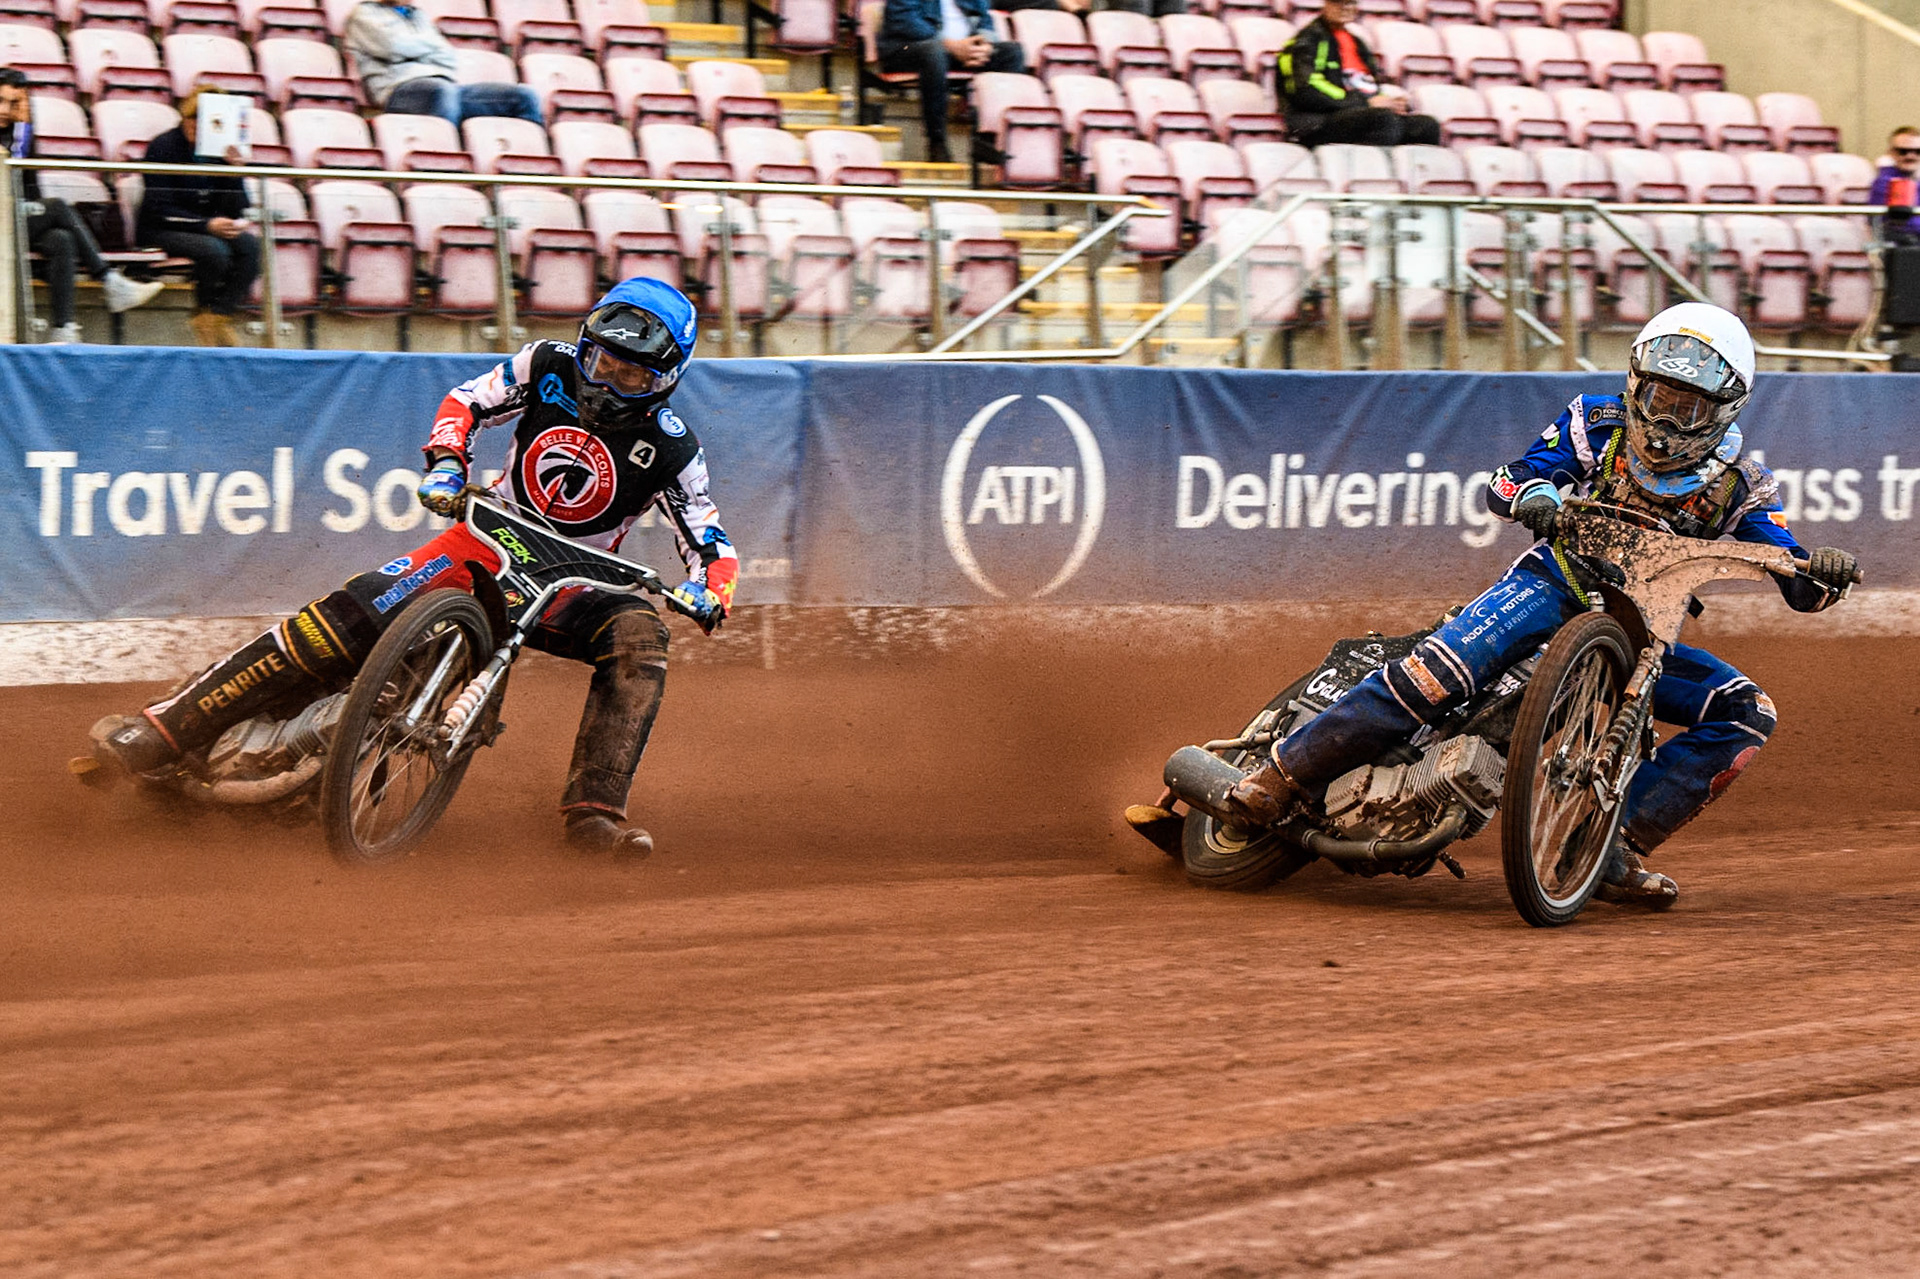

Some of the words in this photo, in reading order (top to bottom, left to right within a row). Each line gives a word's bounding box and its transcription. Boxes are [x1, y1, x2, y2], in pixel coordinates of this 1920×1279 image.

[539, 433, 573, 449] BELLE
[594, 452, 611, 489] COLTS
[635, 446, 654, 465] 4
[25, 447, 294, 537] Travel
[966, 465, 1077, 525] ATPI
[1175, 452, 1500, 548] Delivering
[491, 527, 539, 565] FORK
[372, 582, 406, 614] Metal
[400, 553, 454, 594] Recycling
[1461, 612, 1500, 645] RODLEY
[1500, 587, 1535, 614] MOTORS
[1533, 580, 1550, 590] LT
[198, 651, 287, 716] PENRITE
